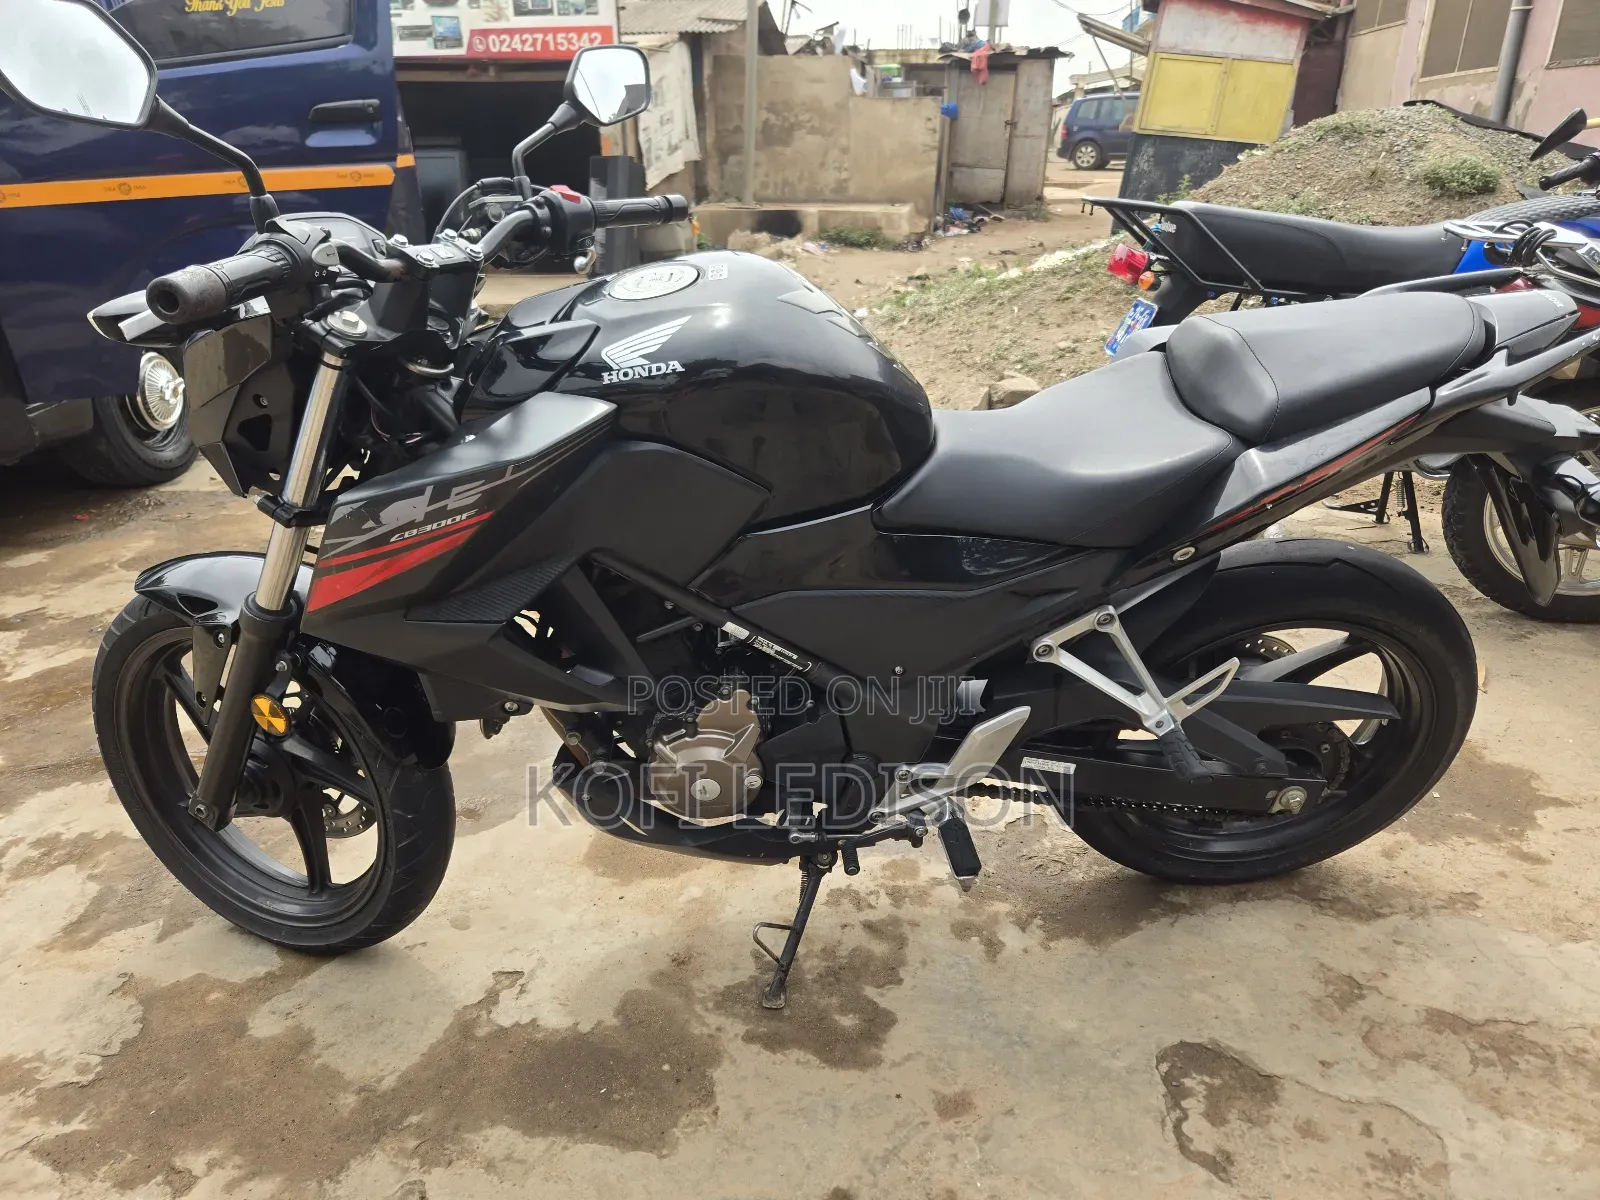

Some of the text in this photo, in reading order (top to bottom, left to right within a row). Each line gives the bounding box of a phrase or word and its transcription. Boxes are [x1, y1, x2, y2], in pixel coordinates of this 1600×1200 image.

[488, 31, 602, 52] 0242715342
[601, 360, 686, 385] HONDA
[389, 508, 479, 543] CB300F
